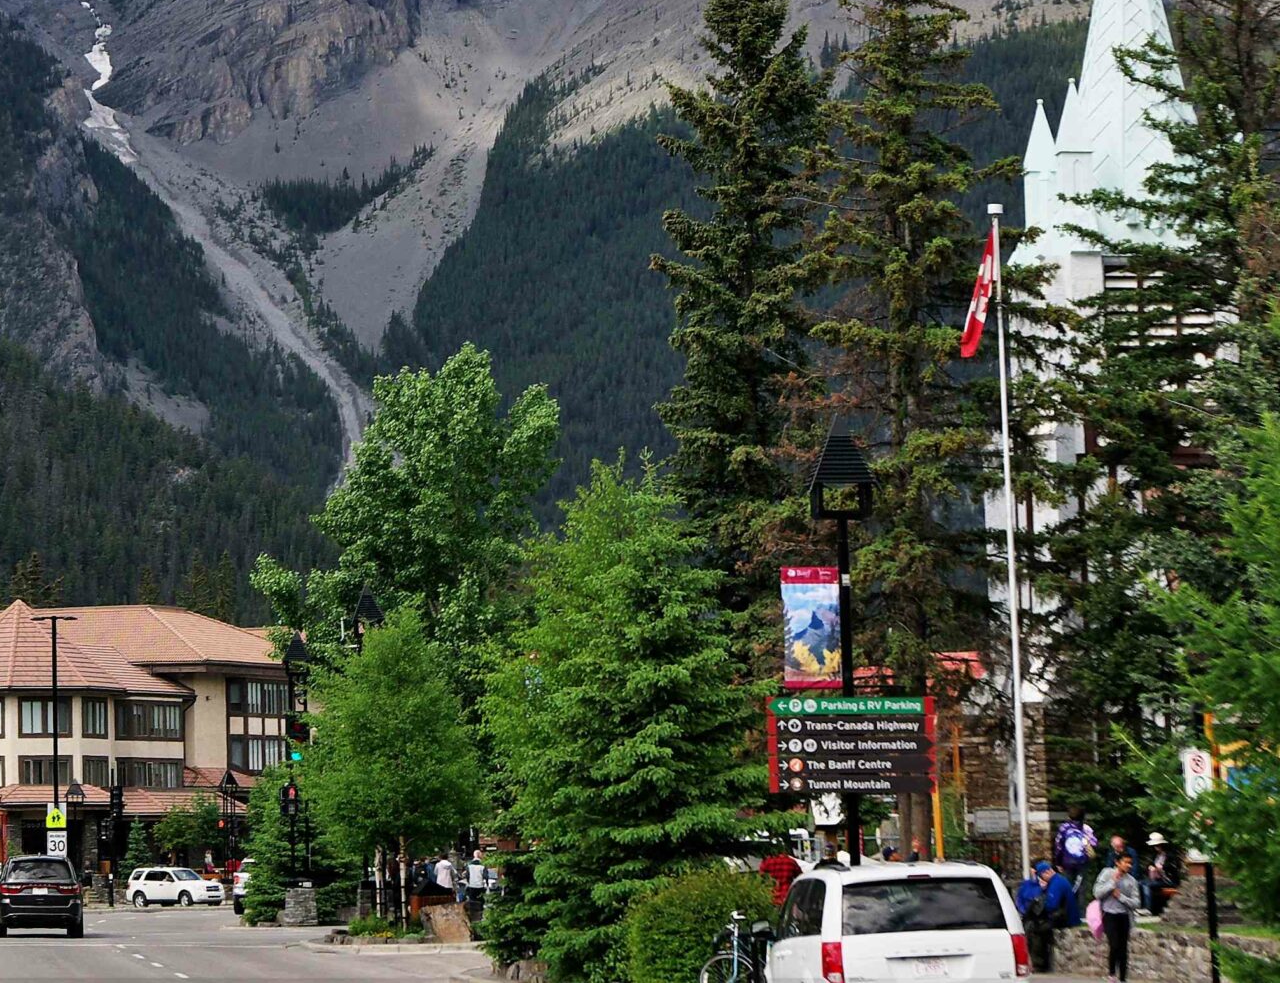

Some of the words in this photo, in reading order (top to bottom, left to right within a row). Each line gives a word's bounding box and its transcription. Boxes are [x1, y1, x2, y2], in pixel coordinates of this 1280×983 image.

[821, 701, 858, 711] Parking
[859, 702, 865, 710] &
[867, 701, 882, 710] RV
[885, 701, 921, 711] Parking
[805, 721, 874, 731] Trans-Canada
[876, 721, 920, 732] Highway
[821, 740, 855, 750] Visitor
[858, 740, 917, 750] Information
[807, 760, 825, 769] The
[828, 760, 855, 769] Banff
[858, 760, 892, 769] Centre
[807, 780, 841, 789] Tunnel
[843, 780, 891, 789] Mountain
[49, 840, 66, 852] 30
